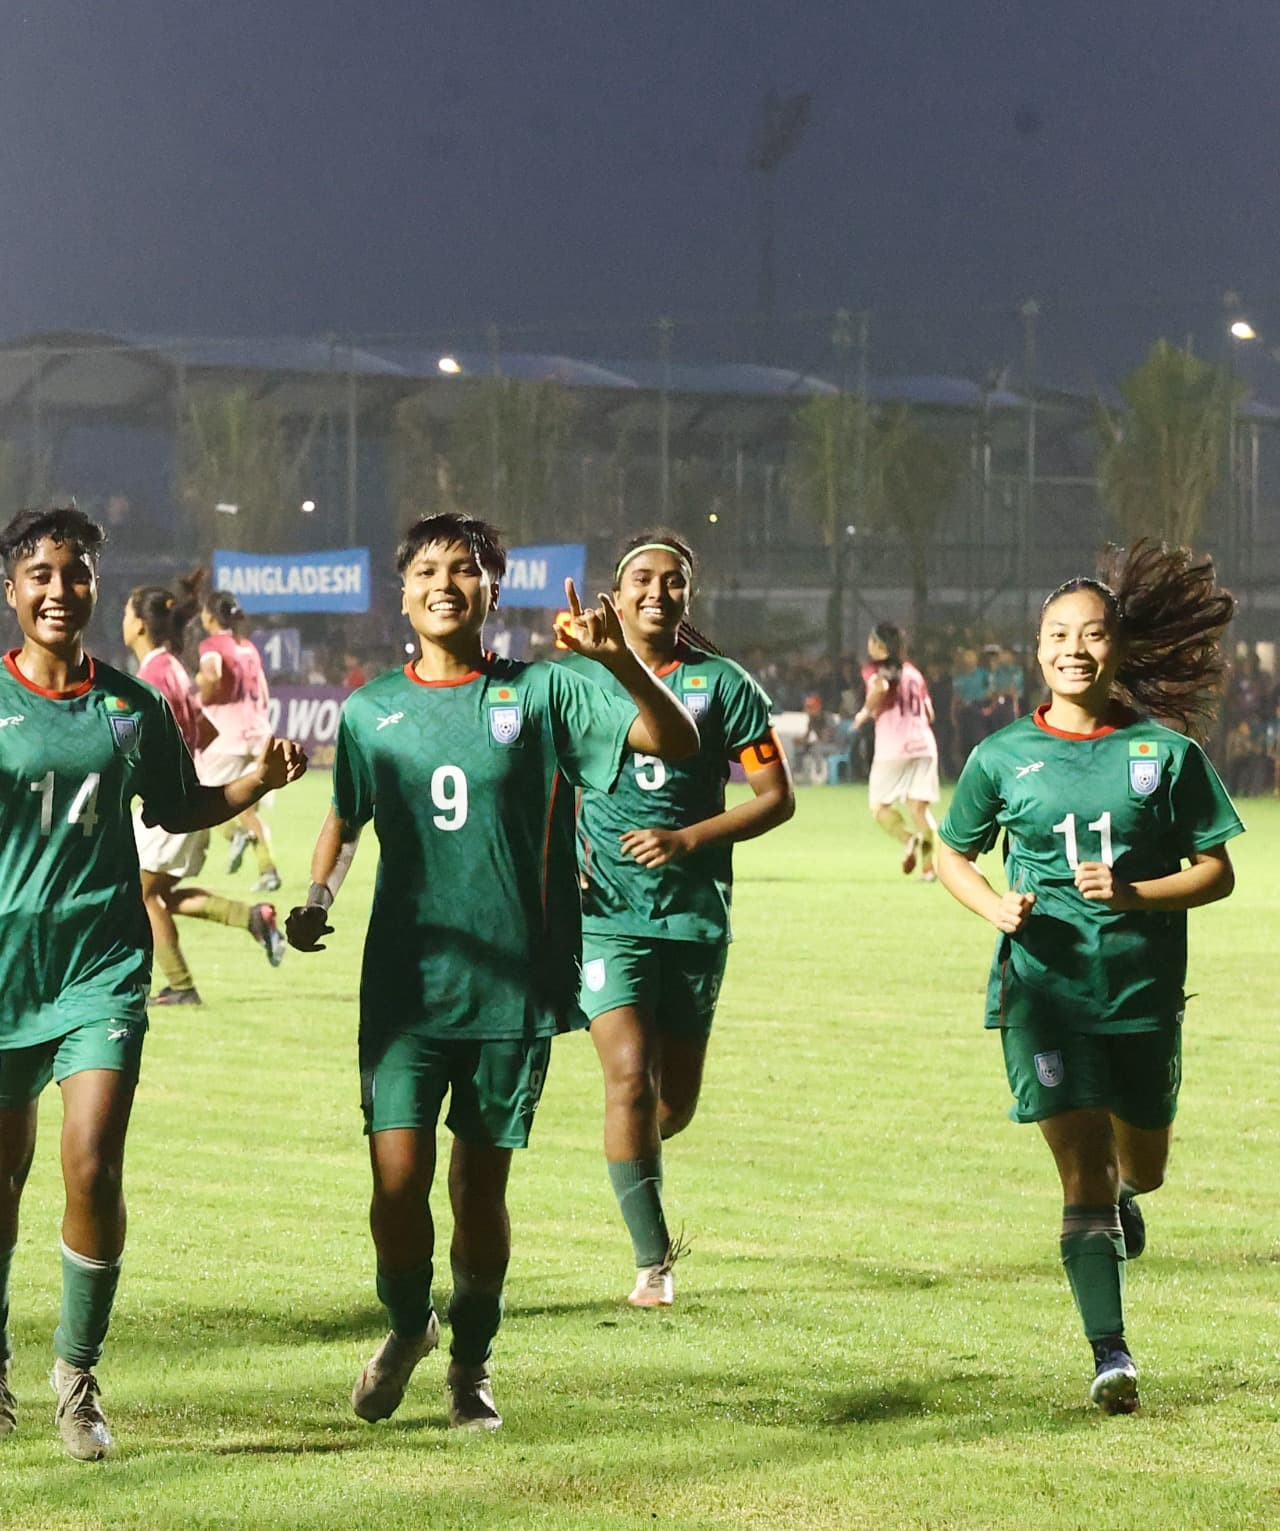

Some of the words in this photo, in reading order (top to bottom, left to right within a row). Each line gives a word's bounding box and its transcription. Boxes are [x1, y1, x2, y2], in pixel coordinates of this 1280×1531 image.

[217, 563, 362, 595] BANGLADESH
[502, 559, 547, 590] TAN
[286, 698, 339, 742] WO
[633, 752, 667, 791] 5
[30, 770, 100, 837] 14
[430, 764, 468, 831] 9
[1052, 811, 1113, 871] 11
[530, 1070, 544, 1099] 9
